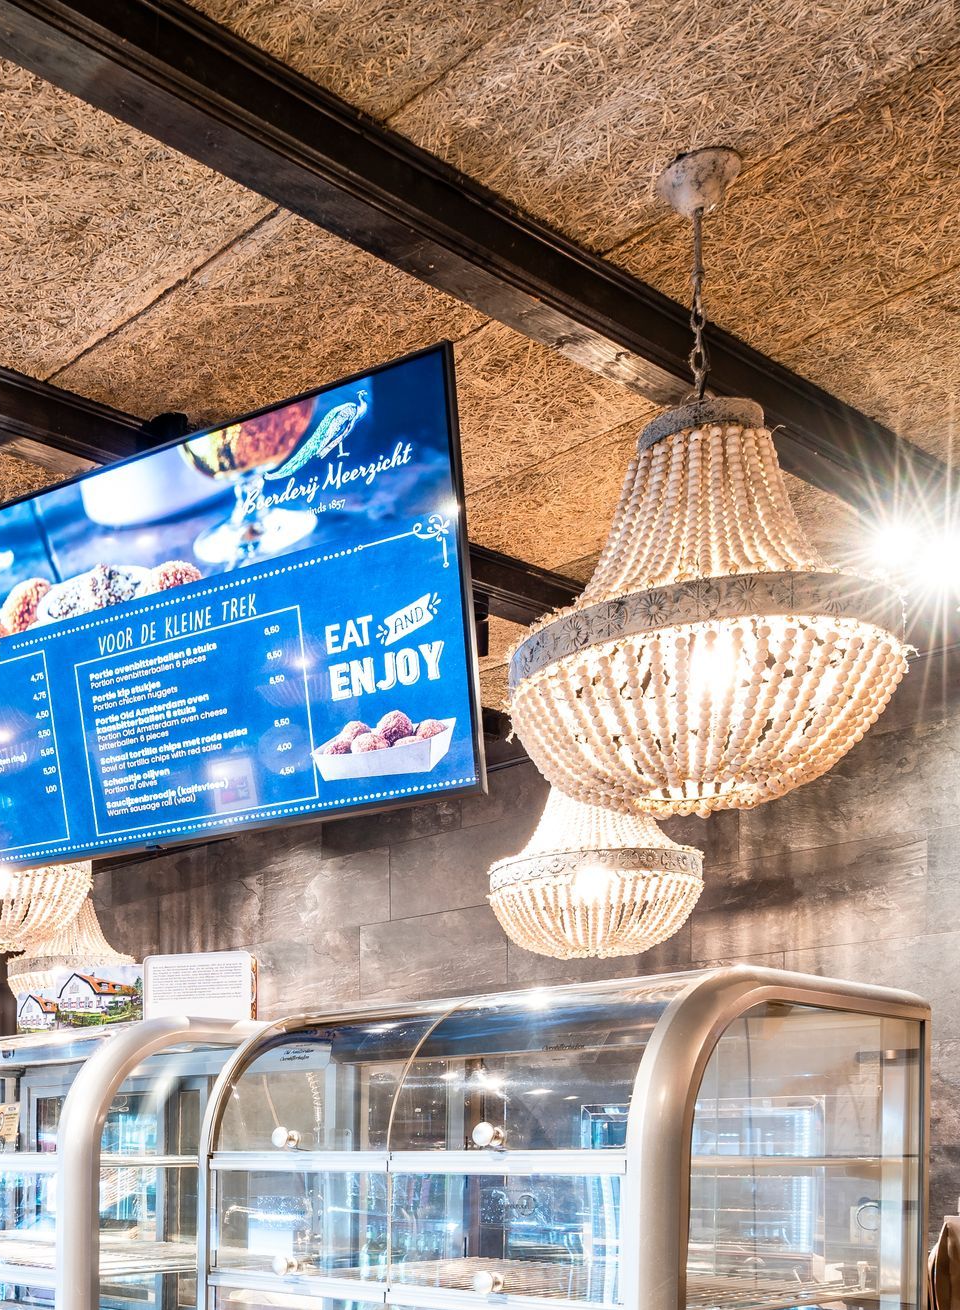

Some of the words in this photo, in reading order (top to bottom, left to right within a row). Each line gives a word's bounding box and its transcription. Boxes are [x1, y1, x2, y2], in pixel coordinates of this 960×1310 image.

[322, 442, 412, 490] Meerzicht
[328, 499, 346, 510] 1857
[98, 627, 132, 655] VOOR
[140, 621, 156, 644] DE
[165, 606, 211, 638] KLEINE
[221, 593, 256, 620] TREK
[394, 606, 423, 632] AND
[325, 614, 372, 654] EAT
[89, 668, 113, 681] Portie
[114, 651, 184, 674] ovenbitterballen
[185, 647, 191, 656] 6
[192, 642, 217, 654] stuks
[90, 678, 114, 688] Portion
[115, 663, 174, 682] ovenbitterballen
[181, 654, 206, 668] pieces
[329, 641, 443, 700] ENJOY
[92, 691, 116, 703] Portie
[116, 687, 130, 698] kip
[130, 681, 160, 694] stukjes
[93, 701, 117, 711] Portion
[118, 694, 146, 705] chicken
[147, 686, 177, 698] nuggets
[35, 710, 48, 719] 4,50
[95, 714, 119, 726] Portie
[119, 709, 134, 720] Old
[135, 699, 186, 716] Amsterdam
[186, 693, 209, 704] oven
[97, 732, 121, 742] Portion
[122, 727, 135, 736] Old
[136, 718, 179, 733] Amsterdam
[180, 714, 199, 723] oven
[200, 707, 227, 719] cheese
[98, 737, 138, 751] bitterballen
[145, 730, 169, 742] pieces
[100, 752, 128, 765] Schaal
[128, 747, 157, 758] tortilla
[158, 742, 181, 752] chips
[182, 737, 200, 747] met
[200, 733, 222, 743] rode
[222, 727, 247, 739] salsa
[276, 742, 292, 752] 4,00
[101, 763, 117, 773] Bowl
[126, 758, 149, 768] tortilla
[150, 753, 170, 763] chips
[170, 749, 186, 758] with
[187, 746, 200, 755] red
[201, 743, 222, 752] salsa
[103, 773, 141, 789] Schaaltje
[142, 768, 170, 779] olijven
[104, 785, 128, 794] Portion
[129, 781, 136, 790] of
[137, 778, 157, 788] olives
[107, 807, 128, 816] Warm
[129, 801, 160, 812] sausage
[161, 797, 173, 806] roll
[173, 793, 196, 805] (veal)
